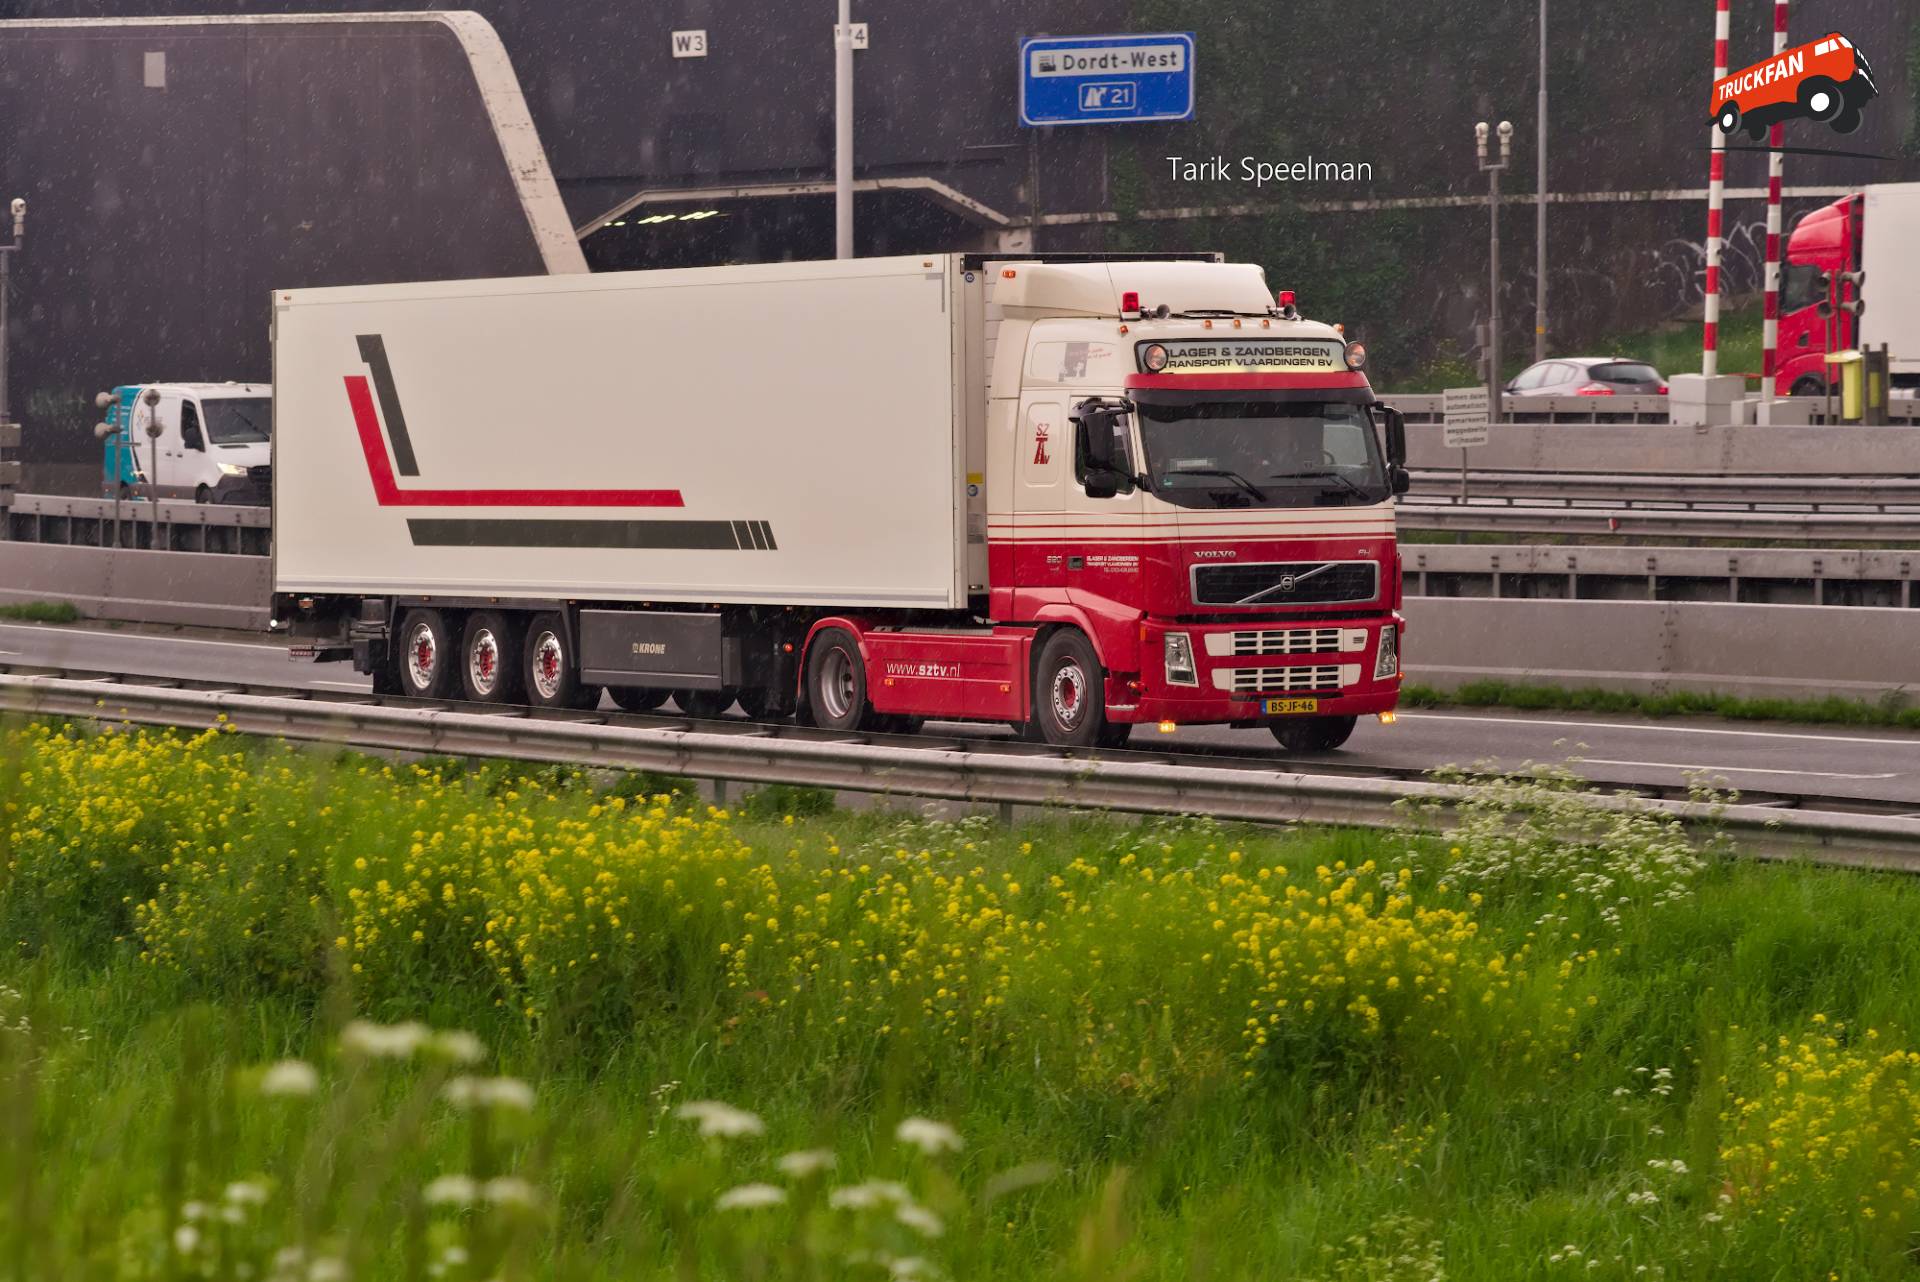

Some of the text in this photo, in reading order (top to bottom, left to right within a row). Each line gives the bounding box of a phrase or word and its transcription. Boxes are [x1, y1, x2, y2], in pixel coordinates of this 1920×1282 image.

[675, 35, 704, 52] W3
[1063, 51, 1178, 71] Dordt-West
[1111, 88, 1130, 104] 21
[1166, 346, 1330, 358] LAGER & ZANDBERGEN
[1235, 358, 1315, 367] VLAARDINGEN
[1318, 359, 1333, 367] BV
[1193, 550, 1237, 559] VOLVO
[639, 642, 666, 655] KRONE
[886, 662, 961, 678] www.sztv.nl
[1271, 701, 1314, 712] BS-JF-46
